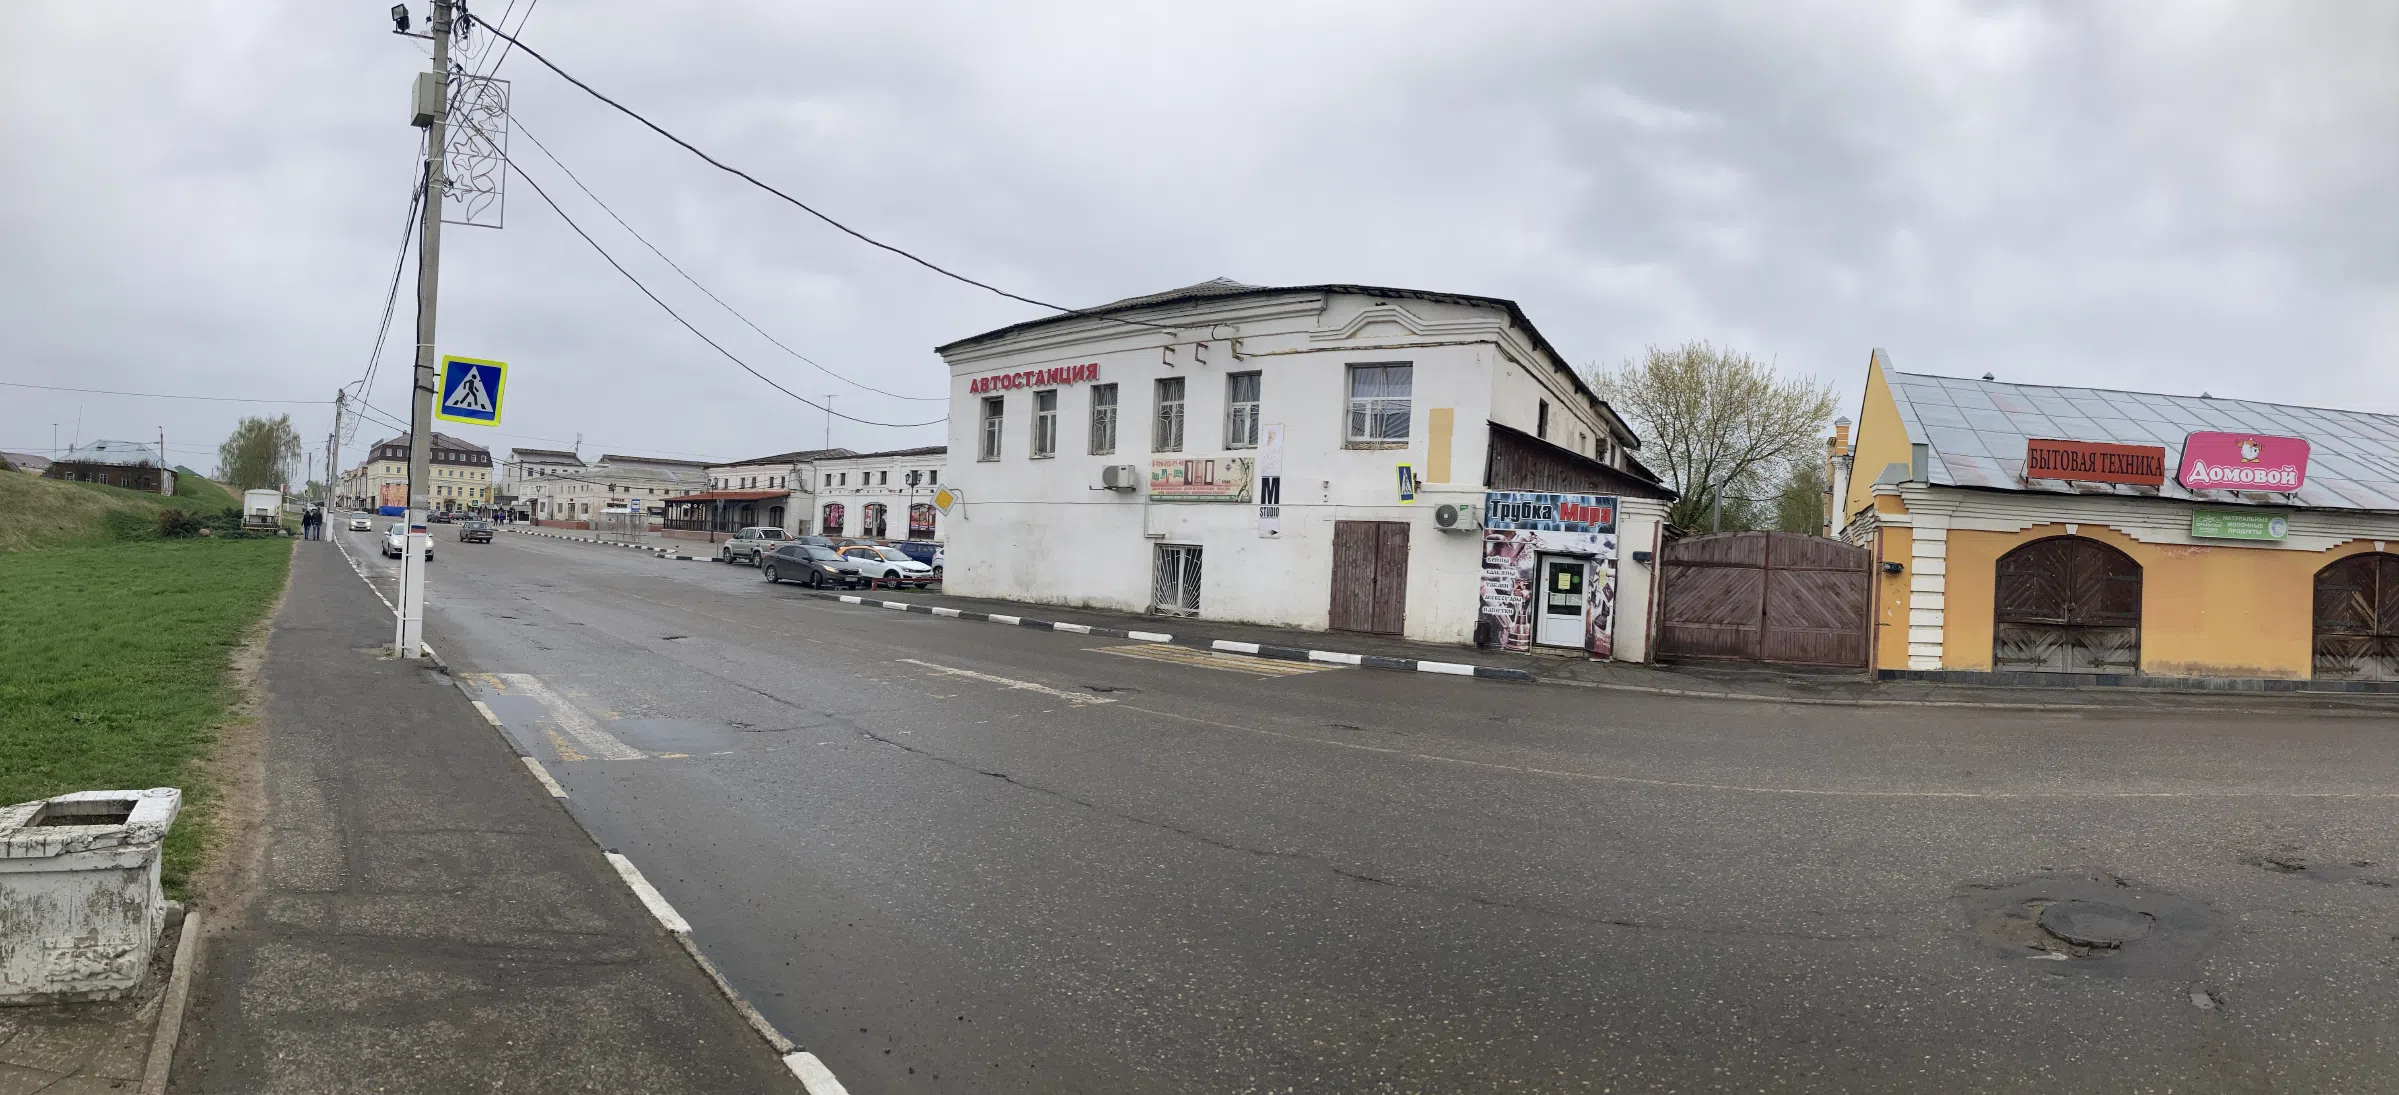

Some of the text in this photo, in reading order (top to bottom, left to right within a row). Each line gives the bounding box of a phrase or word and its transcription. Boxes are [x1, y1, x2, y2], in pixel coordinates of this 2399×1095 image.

[969, 363, 1099, 393] АВТОСТАНЦИЯ
[2029, 448, 2163, 476] БЫТОВАЯ ТЕХНИКА
[1260, 477, 1280, 505] M
[1259, 507, 1280, 517] STUDIO
[1490, 500, 1612, 526] Трубка Мира
